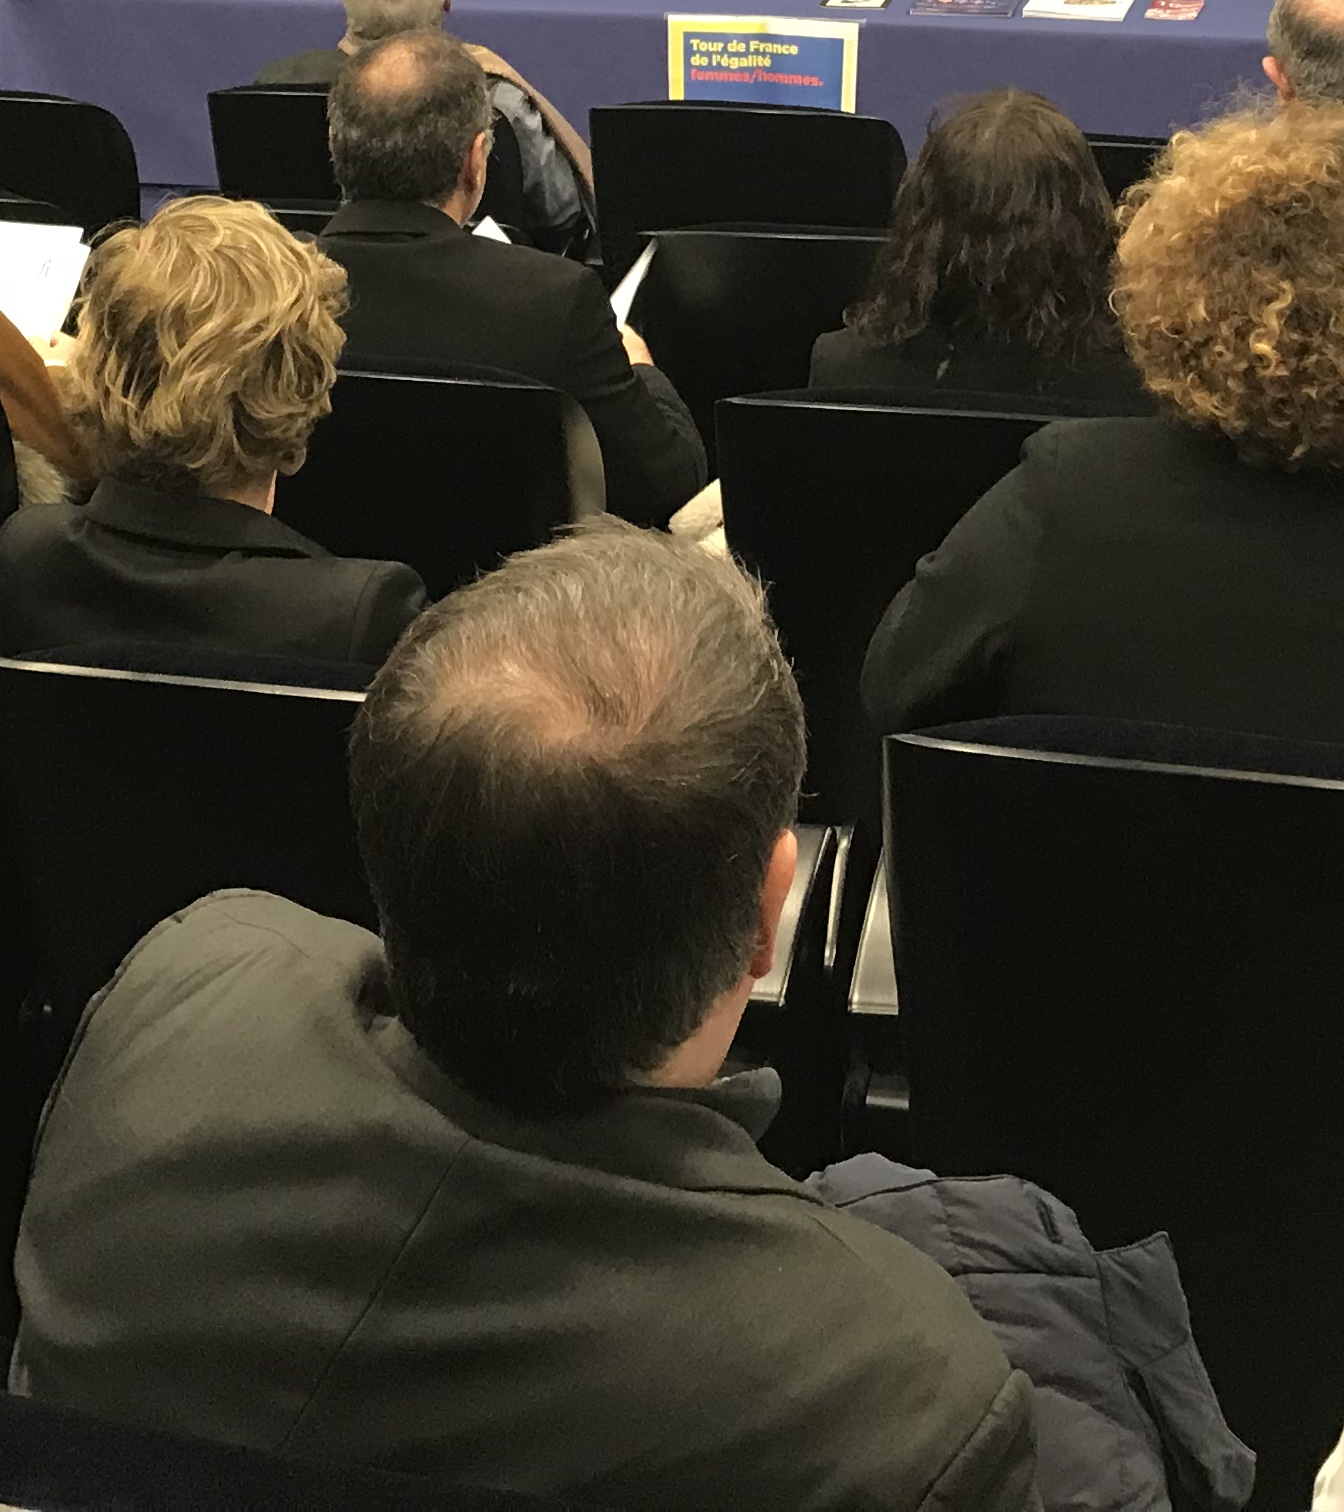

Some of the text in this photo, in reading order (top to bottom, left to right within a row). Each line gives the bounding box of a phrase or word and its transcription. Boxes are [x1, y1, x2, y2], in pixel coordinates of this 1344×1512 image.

[690, 39, 799, 55] Tour de France
[690, 53, 772, 69] de l'égalité
